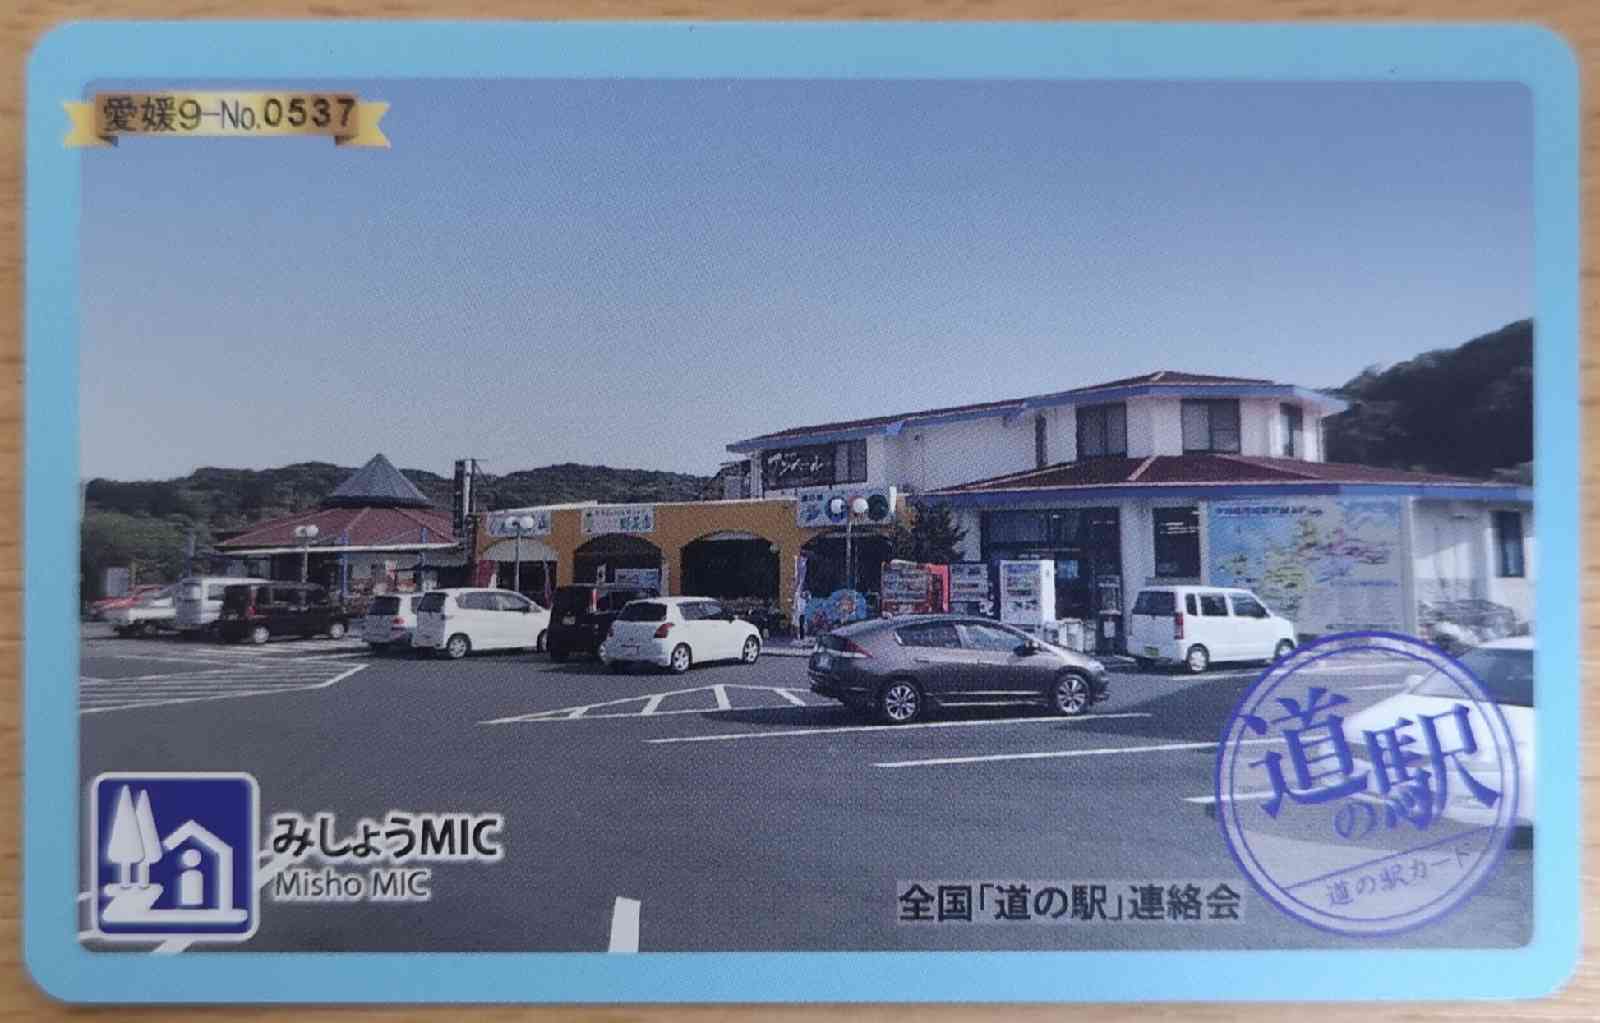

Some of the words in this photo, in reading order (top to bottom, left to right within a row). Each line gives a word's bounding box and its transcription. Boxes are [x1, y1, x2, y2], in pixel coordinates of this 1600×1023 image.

[272, 817, 498, 857] みしょうMIC
[275, 870, 362, 898] Misho
[373, 870, 429, 898] MIC
[899, 883, 1242, 922] 全国「道の駅」連絡会
